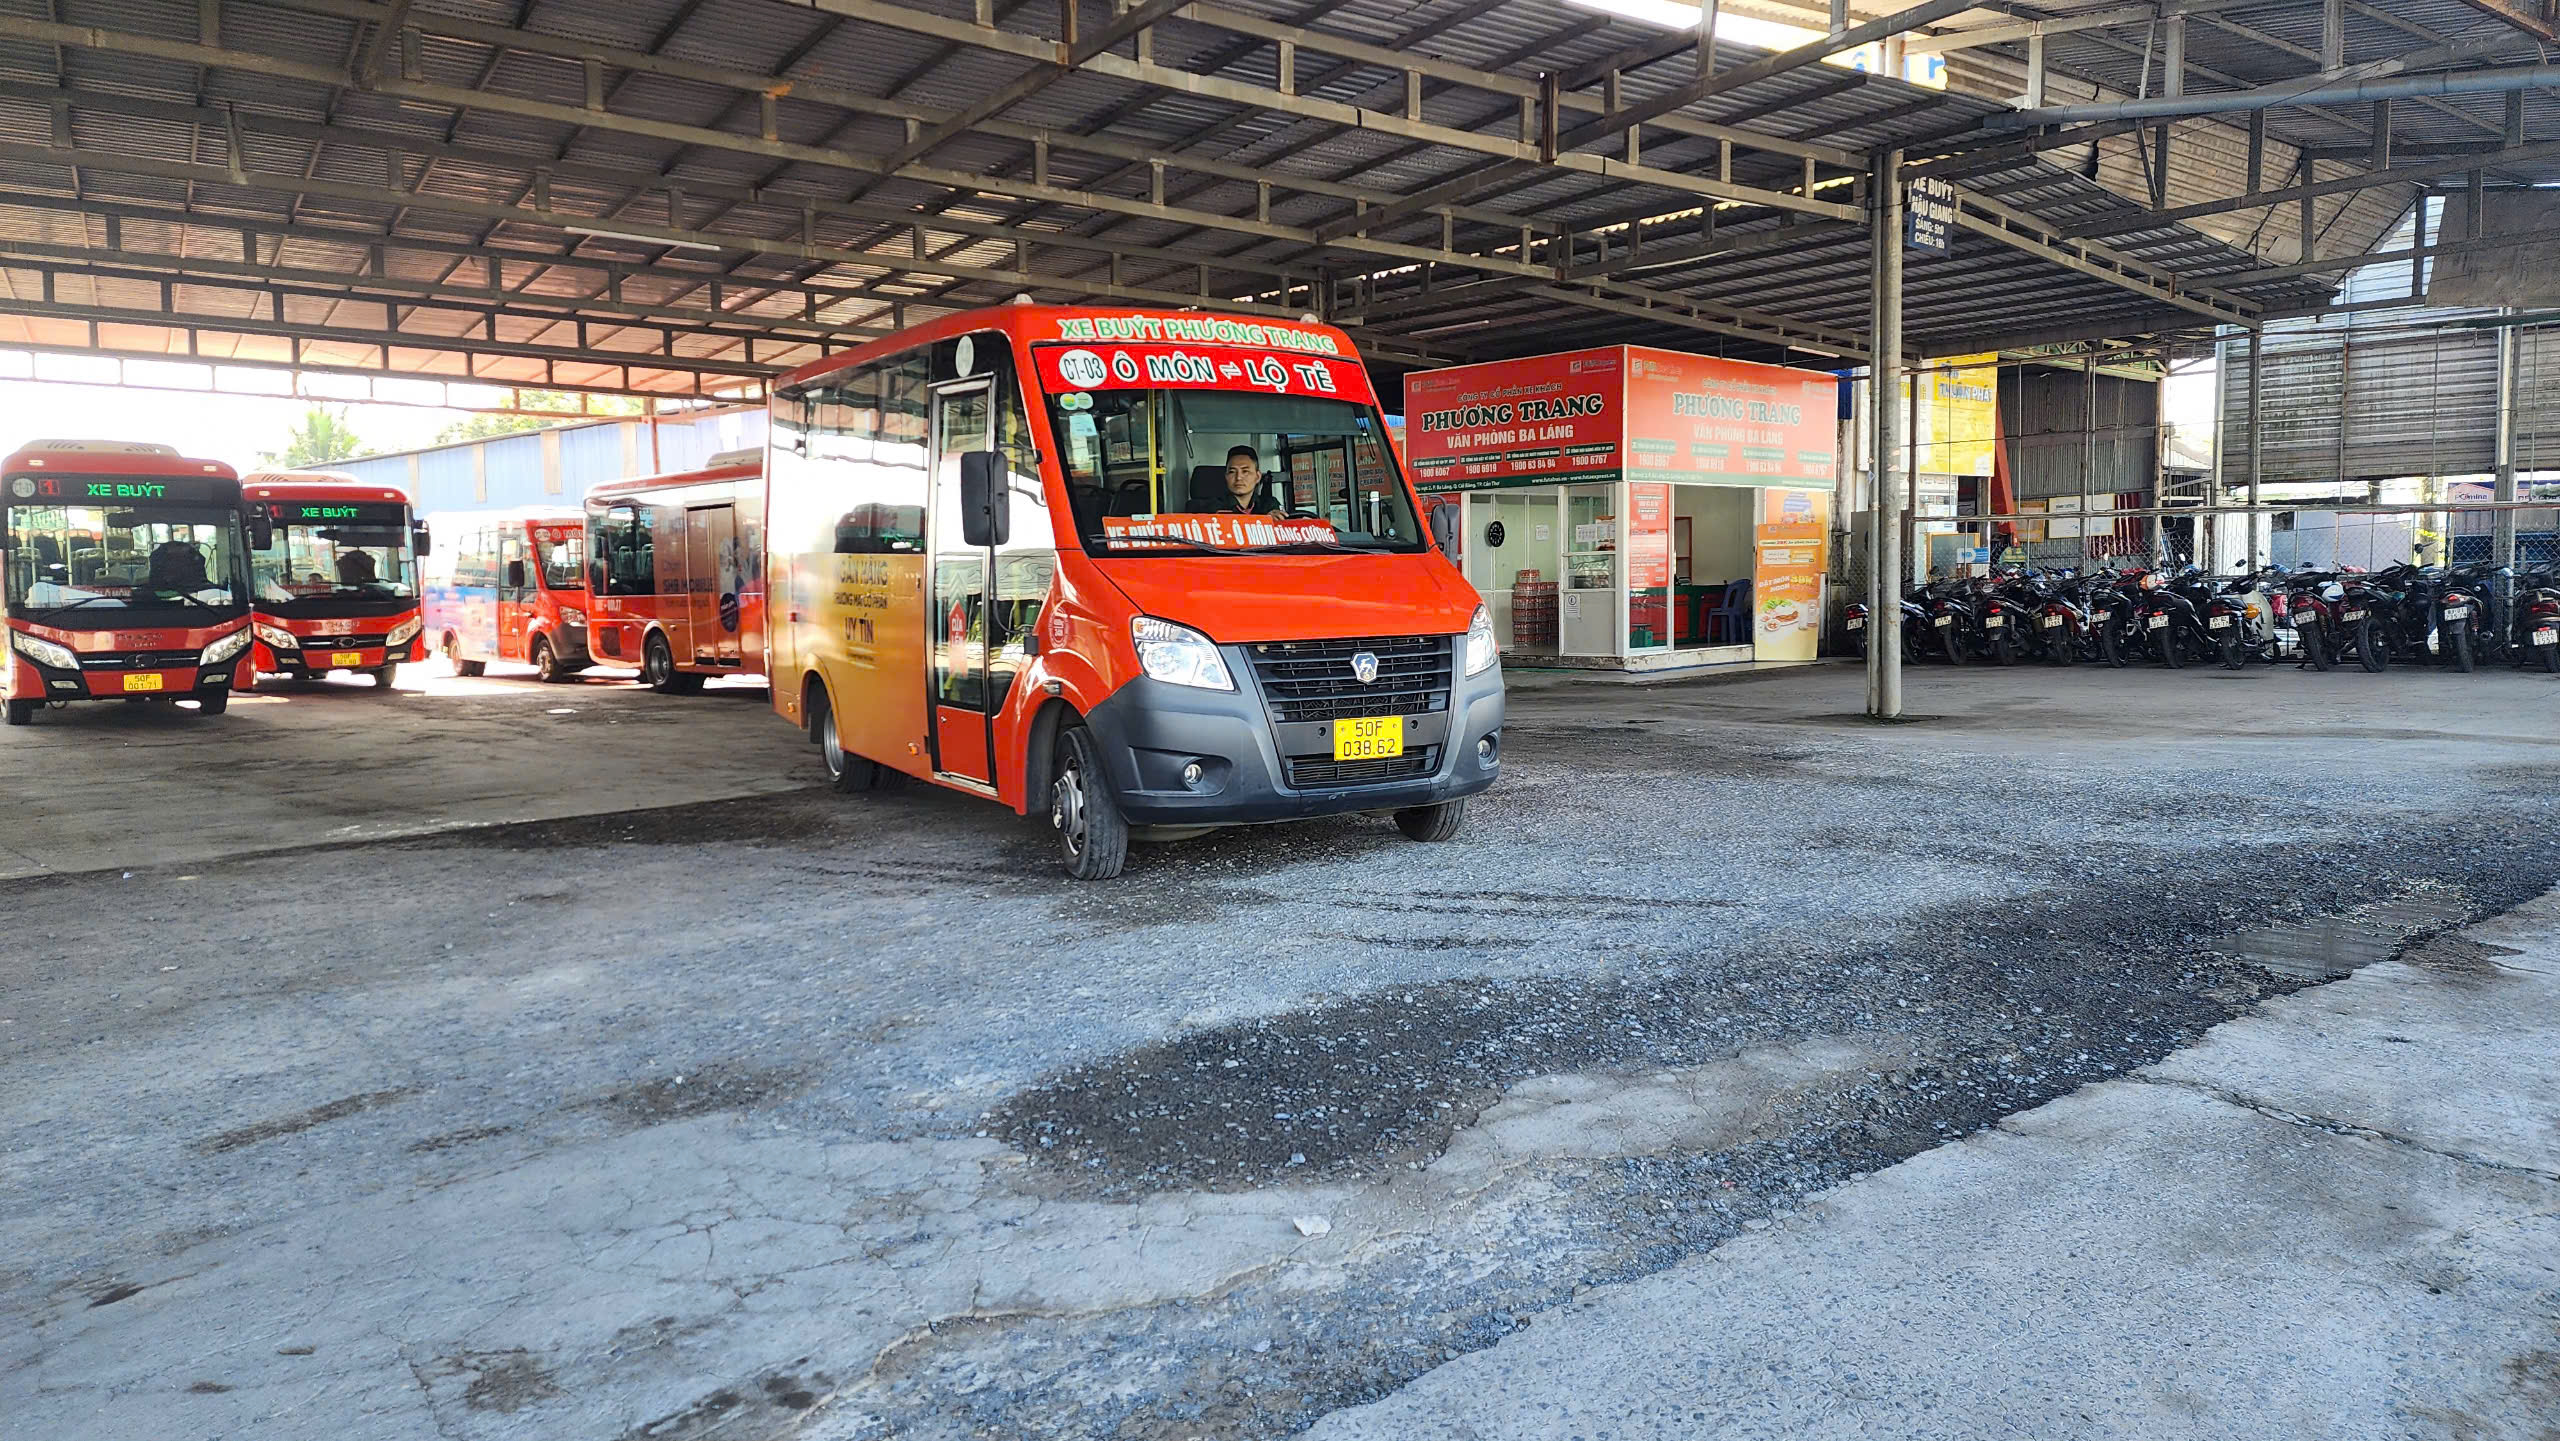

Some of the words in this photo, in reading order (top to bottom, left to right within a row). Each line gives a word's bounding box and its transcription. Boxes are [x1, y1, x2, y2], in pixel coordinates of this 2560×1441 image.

[1928, 179, 1953, 201] BUÝT
[1929, 202, 1953, 224] GIANG
[1057, 319, 1096, 338] XE
[1095, 315, 1161, 339] BUÝT
[1163, 317, 1266, 344] PHƯƠNG
[1262, 326, 1338, 355] TRANG
[1063, 357, 1104, 380] CT-03
[1112, 351, 1138, 382] Ô
[1145, 351, 1217, 383] MÔN
[1244, 356, 1289, 393] LỘ
[1294, 360, 1336, 392] TẺ
[1422, 403, 1513, 432] PHƯƠNG
[1518, 393, 1604, 422] TRANG
[1673, 392, 1744, 420] PHƯƠNG
[1747, 400, 1801, 426] TRANG
[1447, 433, 1471, 449] VĂN
[1474, 429, 1515, 447] PHÒNG
[1519, 428, 1536, 442] BA
[1539, 424, 1574, 440] LÁNG
[1465, 464, 1481, 474] 1900
[1481, 463, 1497, 473] 6919
[1511, 460, 1527, 471] 1900
[1527, 460, 1537, 470] 63
[1537, 459, 1546, 469] 84
[1547, 458, 1556, 468] 94
[1572, 456, 1589, 466] 1900
[1420, 468, 1434, 478] 1900
[87, 483, 112, 496] XE
[117, 481, 165, 497] BUÝT
[301, 507, 320, 518] XE
[322, 505, 357, 518] BUÝT
[1204, 517, 1225, 545] TẺ
[1232, 519, 1245, 546] Ô
[1245, 520, 1277, 546] MÔN
[1274, 527, 1300, 543] TĂNG
[1300, 526, 1335, 543] CƯỜNG
[845, 616, 857, 641] UY
[859, 613, 874, 644] TÍN
[135, 674, 151, 683] 50F
[1355, 720, 1383, 737] 50F
[1343, 739, 1396, 757] 038.62
